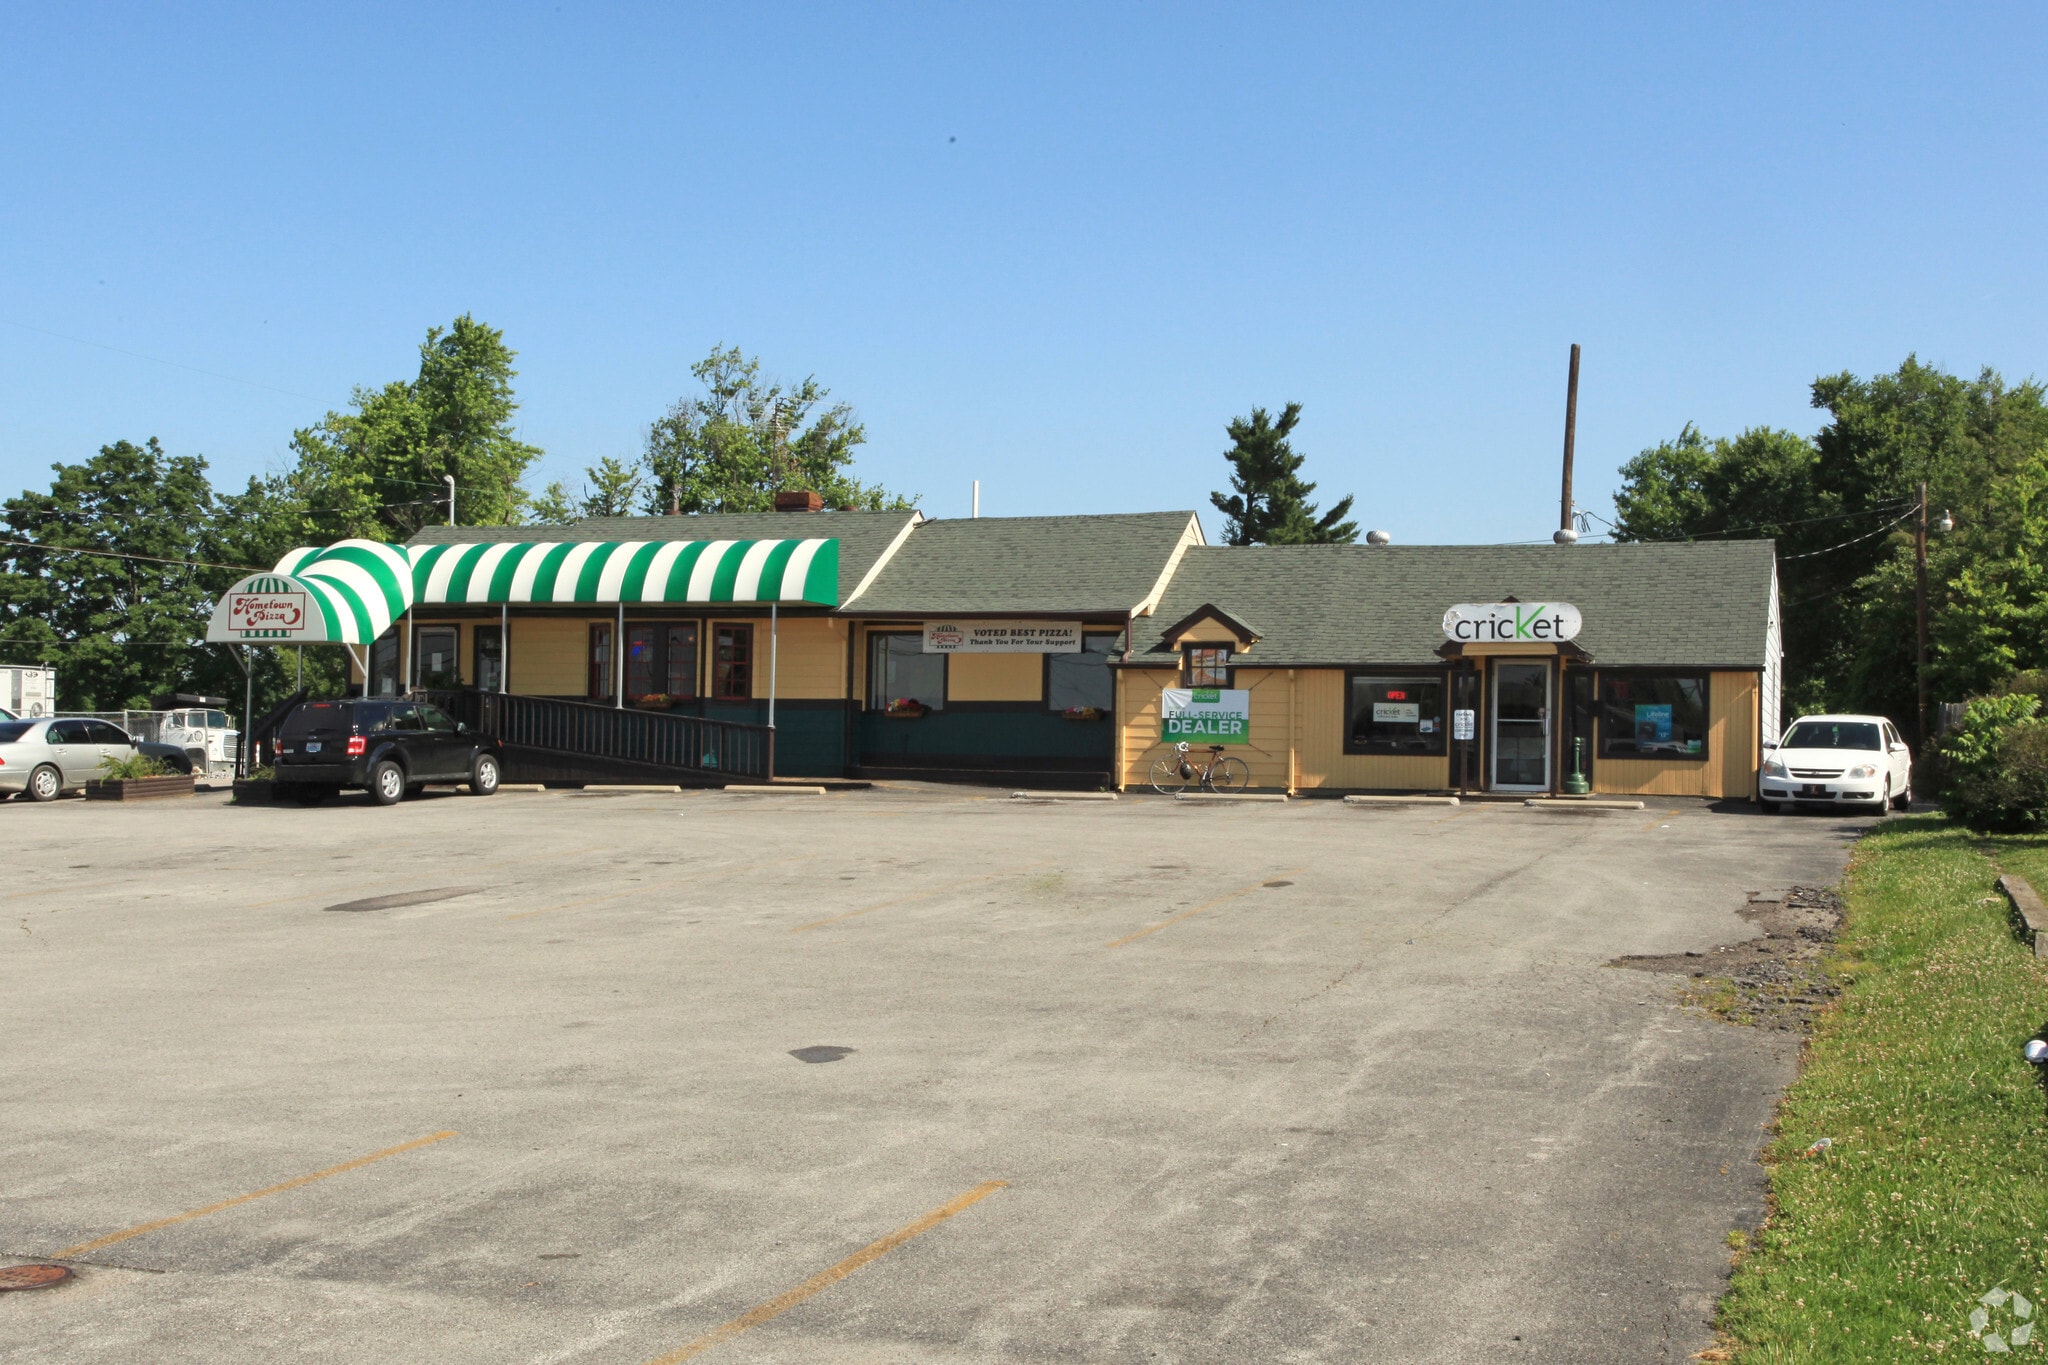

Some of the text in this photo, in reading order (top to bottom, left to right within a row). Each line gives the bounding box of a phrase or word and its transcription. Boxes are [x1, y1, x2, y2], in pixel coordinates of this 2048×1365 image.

[233, 597, 293, 615] Hometown
[246, 609, 301, 627] Pizza
[1455, 605, 1565, 640] cricket
[974, 629, 1073, 637] VOTED BEST PIZZA!
[1045, 638, 1076, 647] Support
[1194, 692, 1218, 700] cricket
[1168, 710, 1243, 720] FULL-SERVICE
[1168, 720, 1243, 735] DEALER
